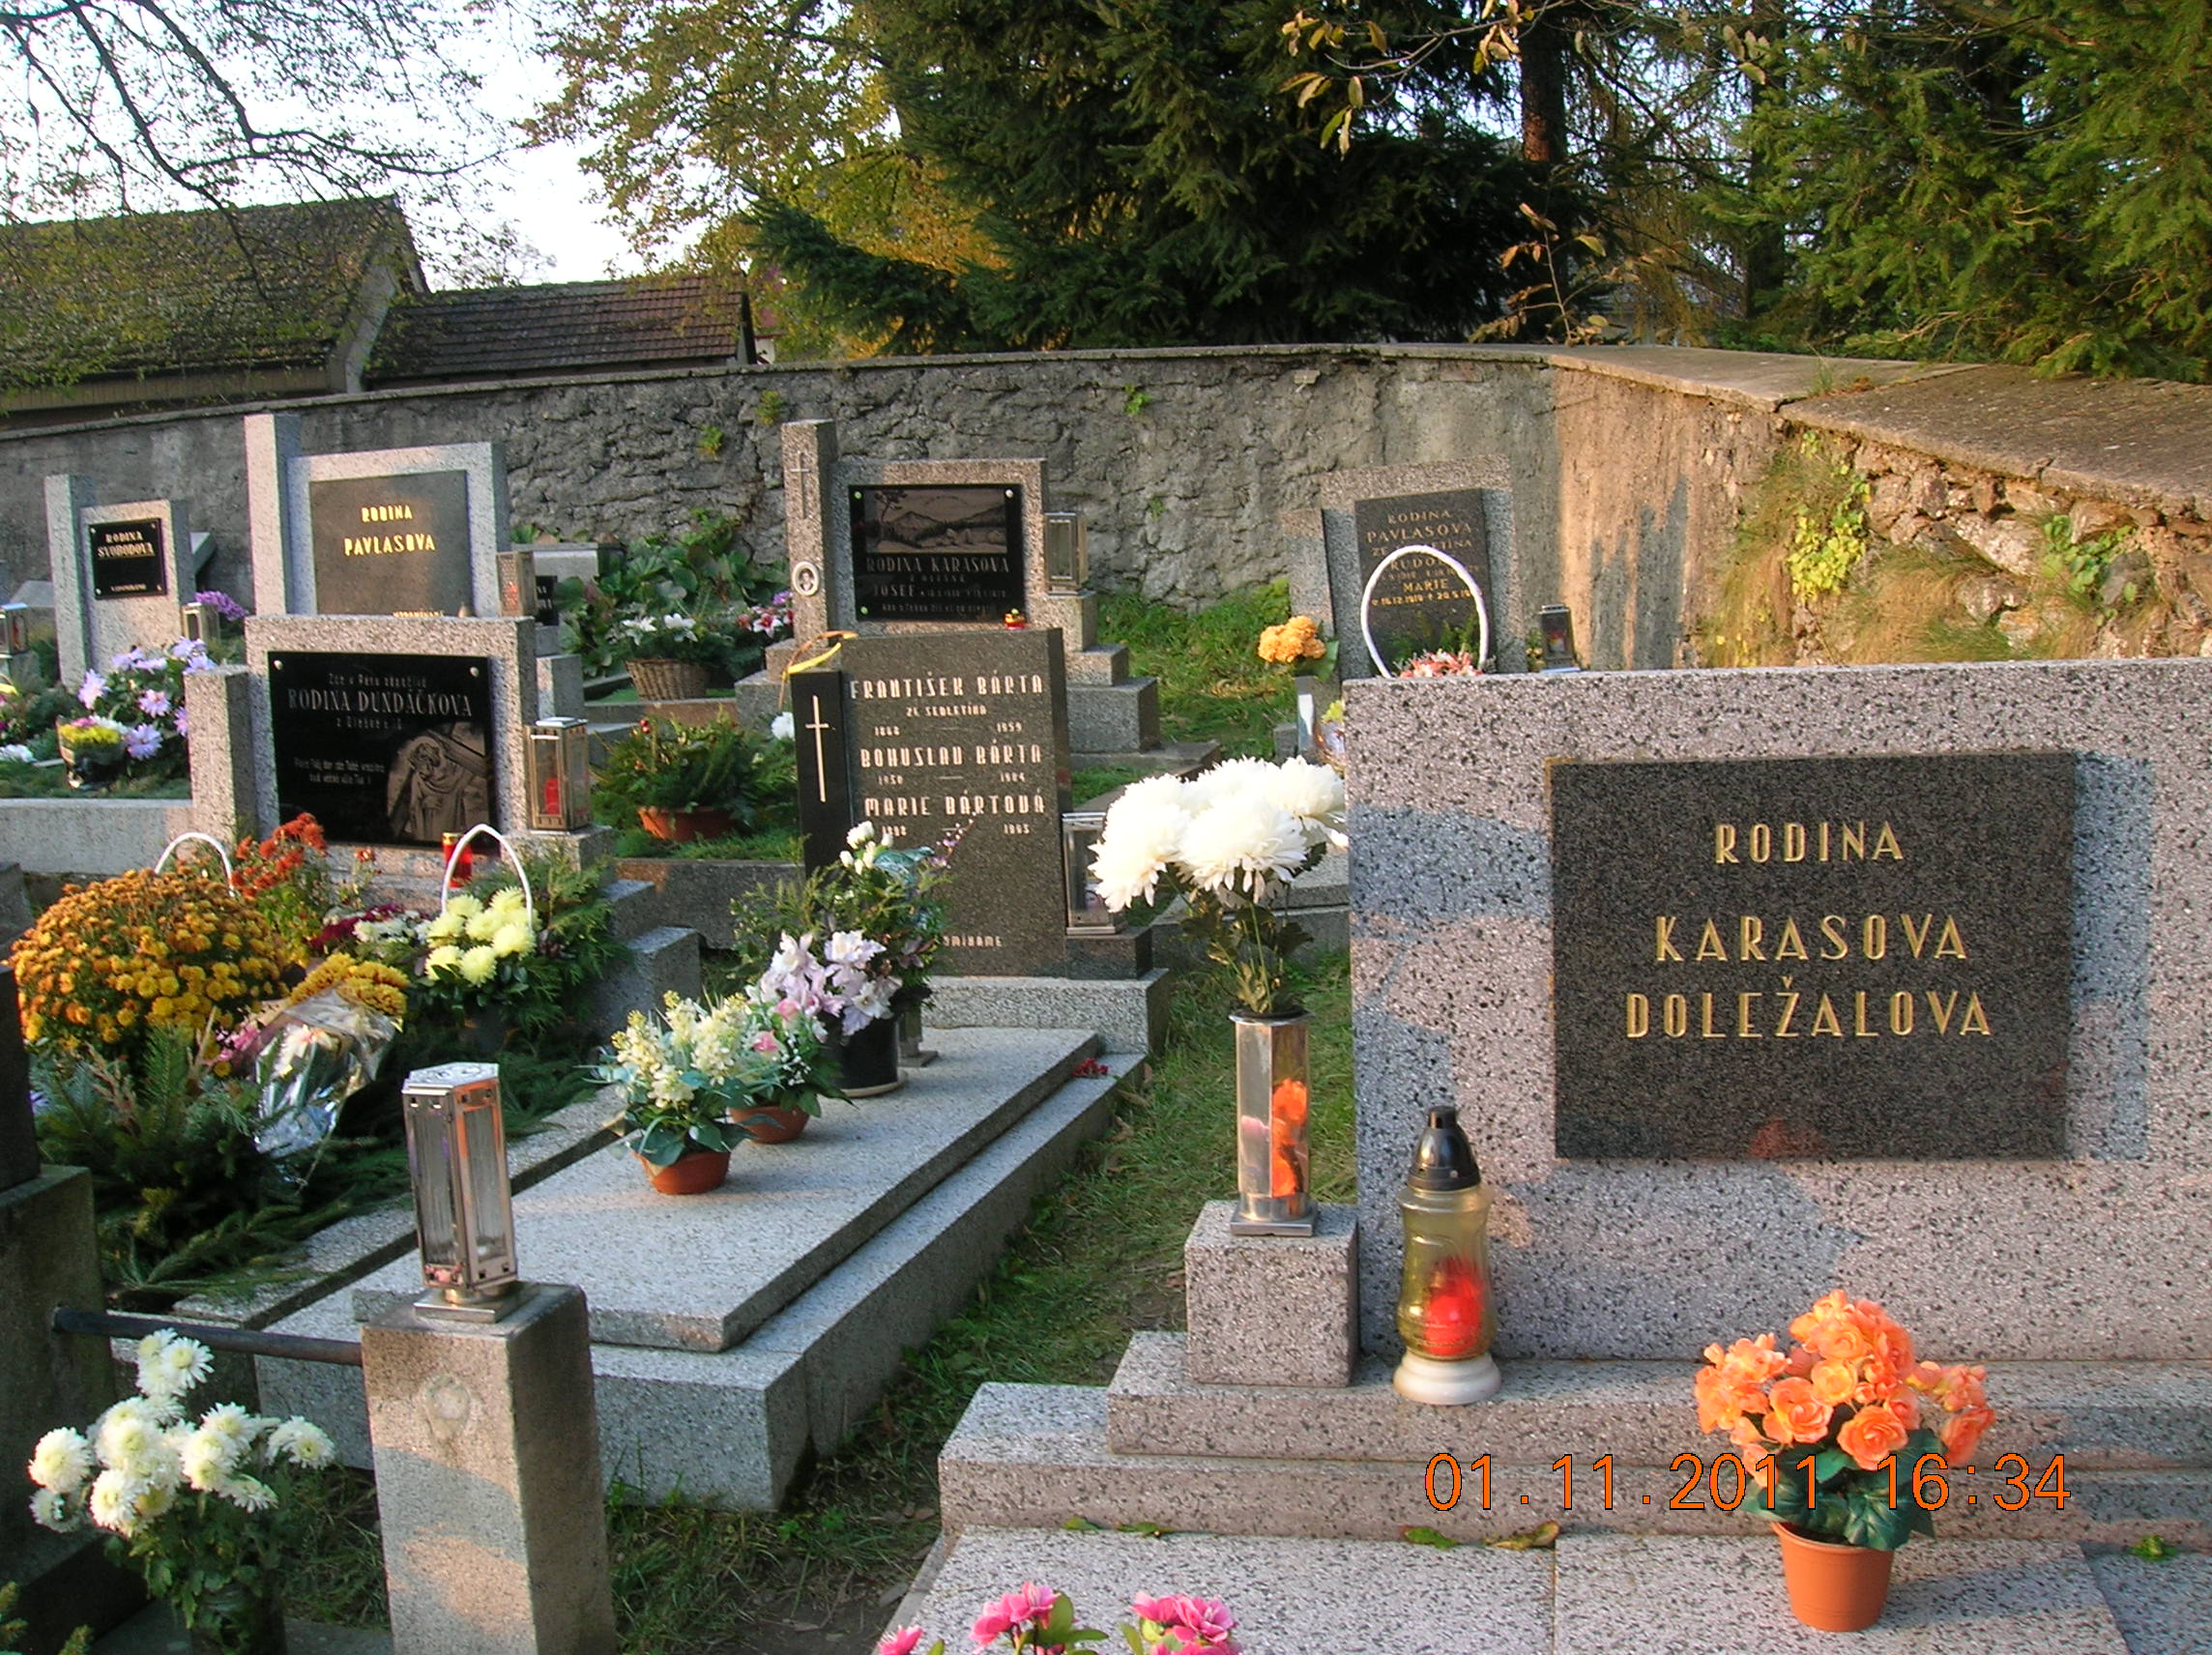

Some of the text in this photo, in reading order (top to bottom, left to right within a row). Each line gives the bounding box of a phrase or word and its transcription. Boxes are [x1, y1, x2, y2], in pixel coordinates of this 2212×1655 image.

[361, 505, 413, 523] RODINA
[1387, 510, 1451, 525] RODINA
[104, 531, 144, 543] RODINA
[1366, 523, 1471, 543] PAVLASOVA
[344, 534, 435, 557] PAVLASOVA
[867, 556, 1009, 573] RODINA KARASOVA
[1389, 556, 1450, 571] RUDO
[1403, 579, 1449, 593] MARIE
[851, 669, 1044, 700] FRANTIŠEK BÁRTA
[288, 689, 473, 717] RODINA DUNDÁČKOVA
[975, 739, 1042, 765] BÁRTA
[864, 797, 931, 818] MARIE
[1714, 822, 1904, 863] RODINA
[1655, 914, 1967, 962] KARASOVA
[1625, 974, 1992, 1038] DOLEŽALOVA
